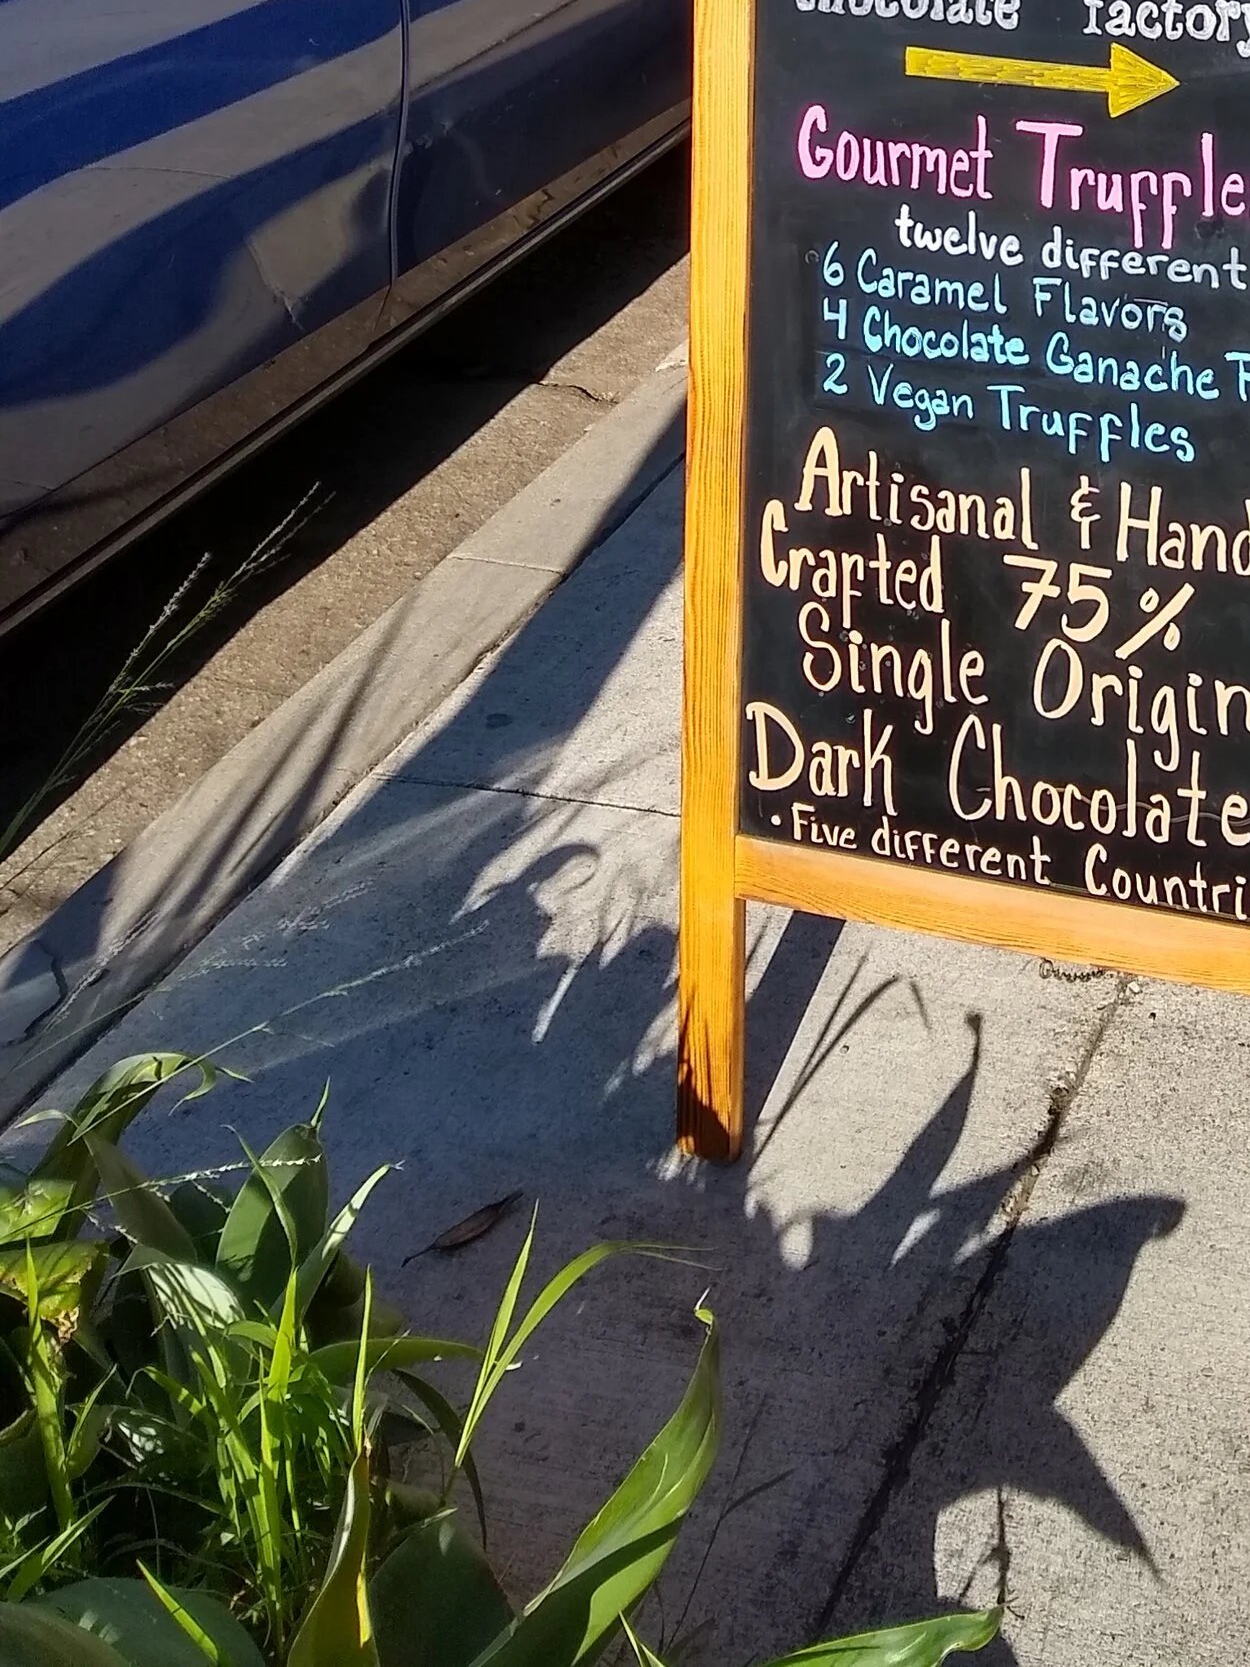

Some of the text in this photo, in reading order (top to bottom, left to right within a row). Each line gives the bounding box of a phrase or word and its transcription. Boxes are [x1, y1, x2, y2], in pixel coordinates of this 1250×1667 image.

[798, 104, 994, 200] Gourmet
[822, 240, 1189, 343] 6 Caramel Flavors
[894, 202, 1025, 266] twelve
[1041, 225, 1249, 291] different
[822, 296, 848, 340] 4
[862, 305, 1031, 366] Chocolate
[1045, 331, 1221, 401] Ganache
[822, 352, 1196, 463] 2 Vegan Truffles
[793, 426, 1039, 551] Artisanal
[1069, 474, 1101, 550] &
[760, 498, 945, 629] Crafted
[798, 601, 989, 735] Single
[745, 701, 898, 817] Dark
[791, 802, 858, 850] Five
[871, 815, 1053, 886] different
